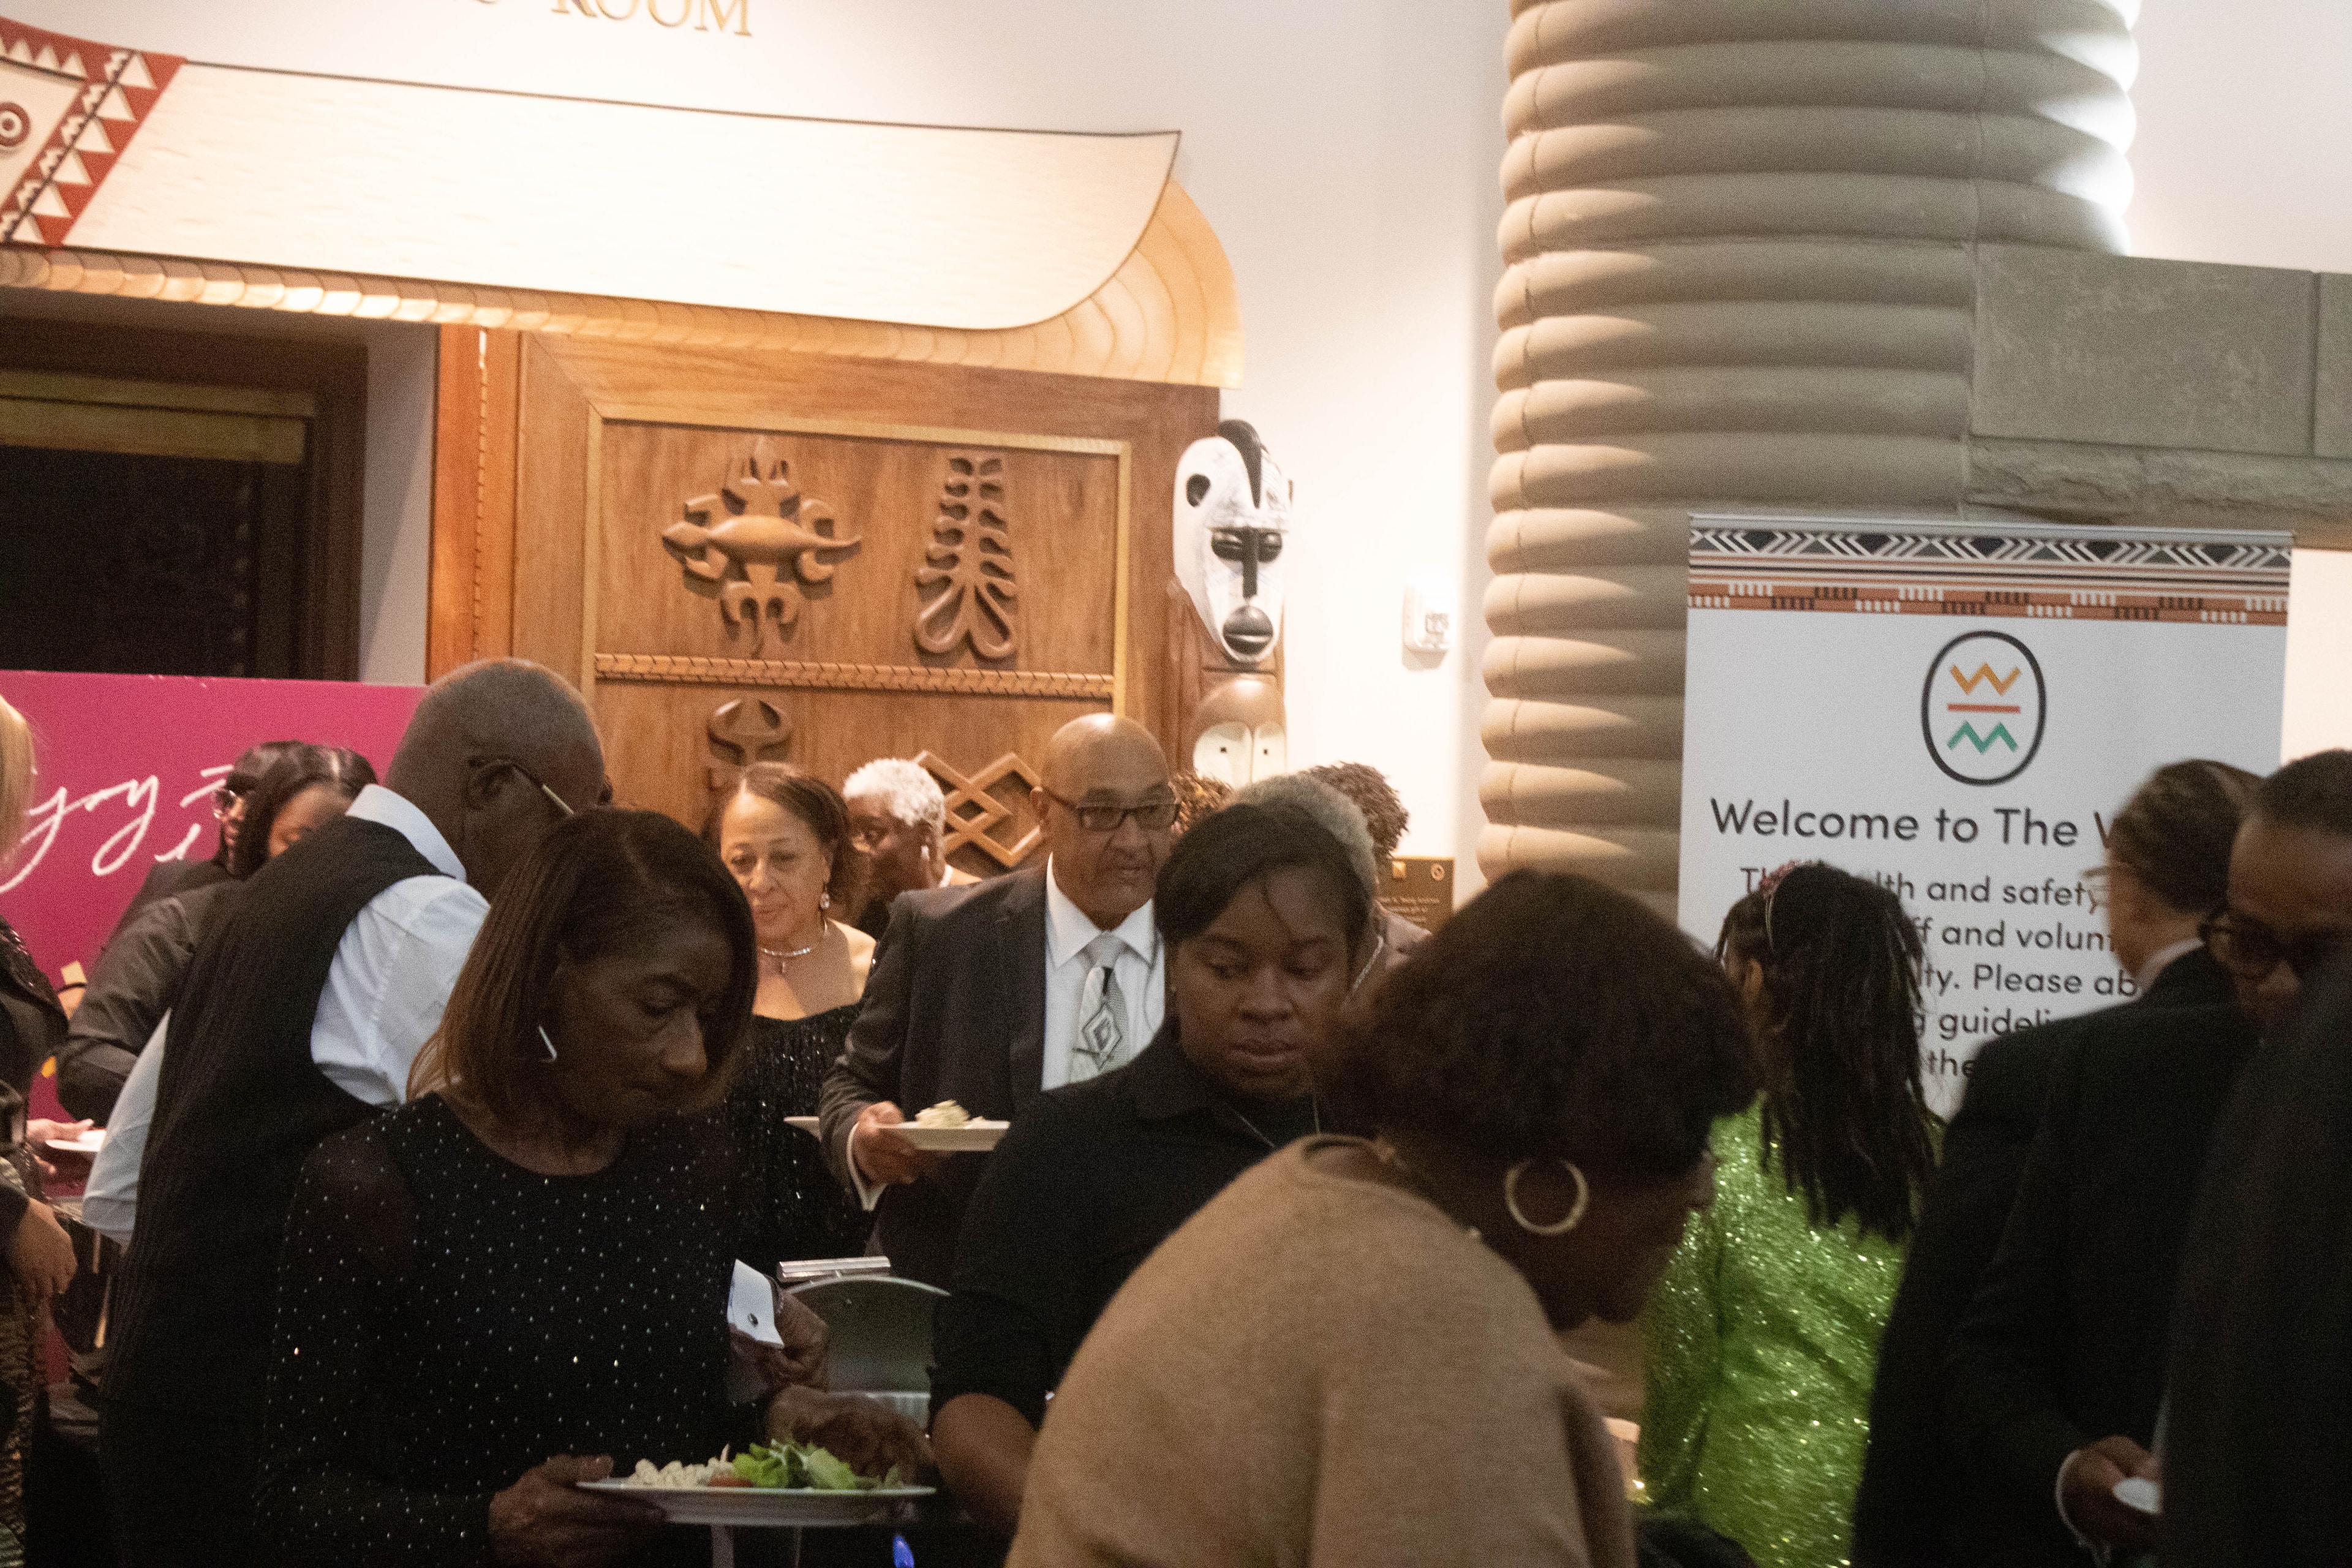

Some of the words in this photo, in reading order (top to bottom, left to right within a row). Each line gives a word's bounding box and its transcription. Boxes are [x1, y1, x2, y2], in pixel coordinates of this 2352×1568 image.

[1711, 797, 1919, 841] Welcome
[1935, 807, 1978, 843] to
[1994, 807, 2078, 847] The
[1927, 875, 1991, 903] and
[1942, 919, 2005, 948] and
[1973, 963, 2082, 994] Please
[2094, 968, 2138, 997] ab
